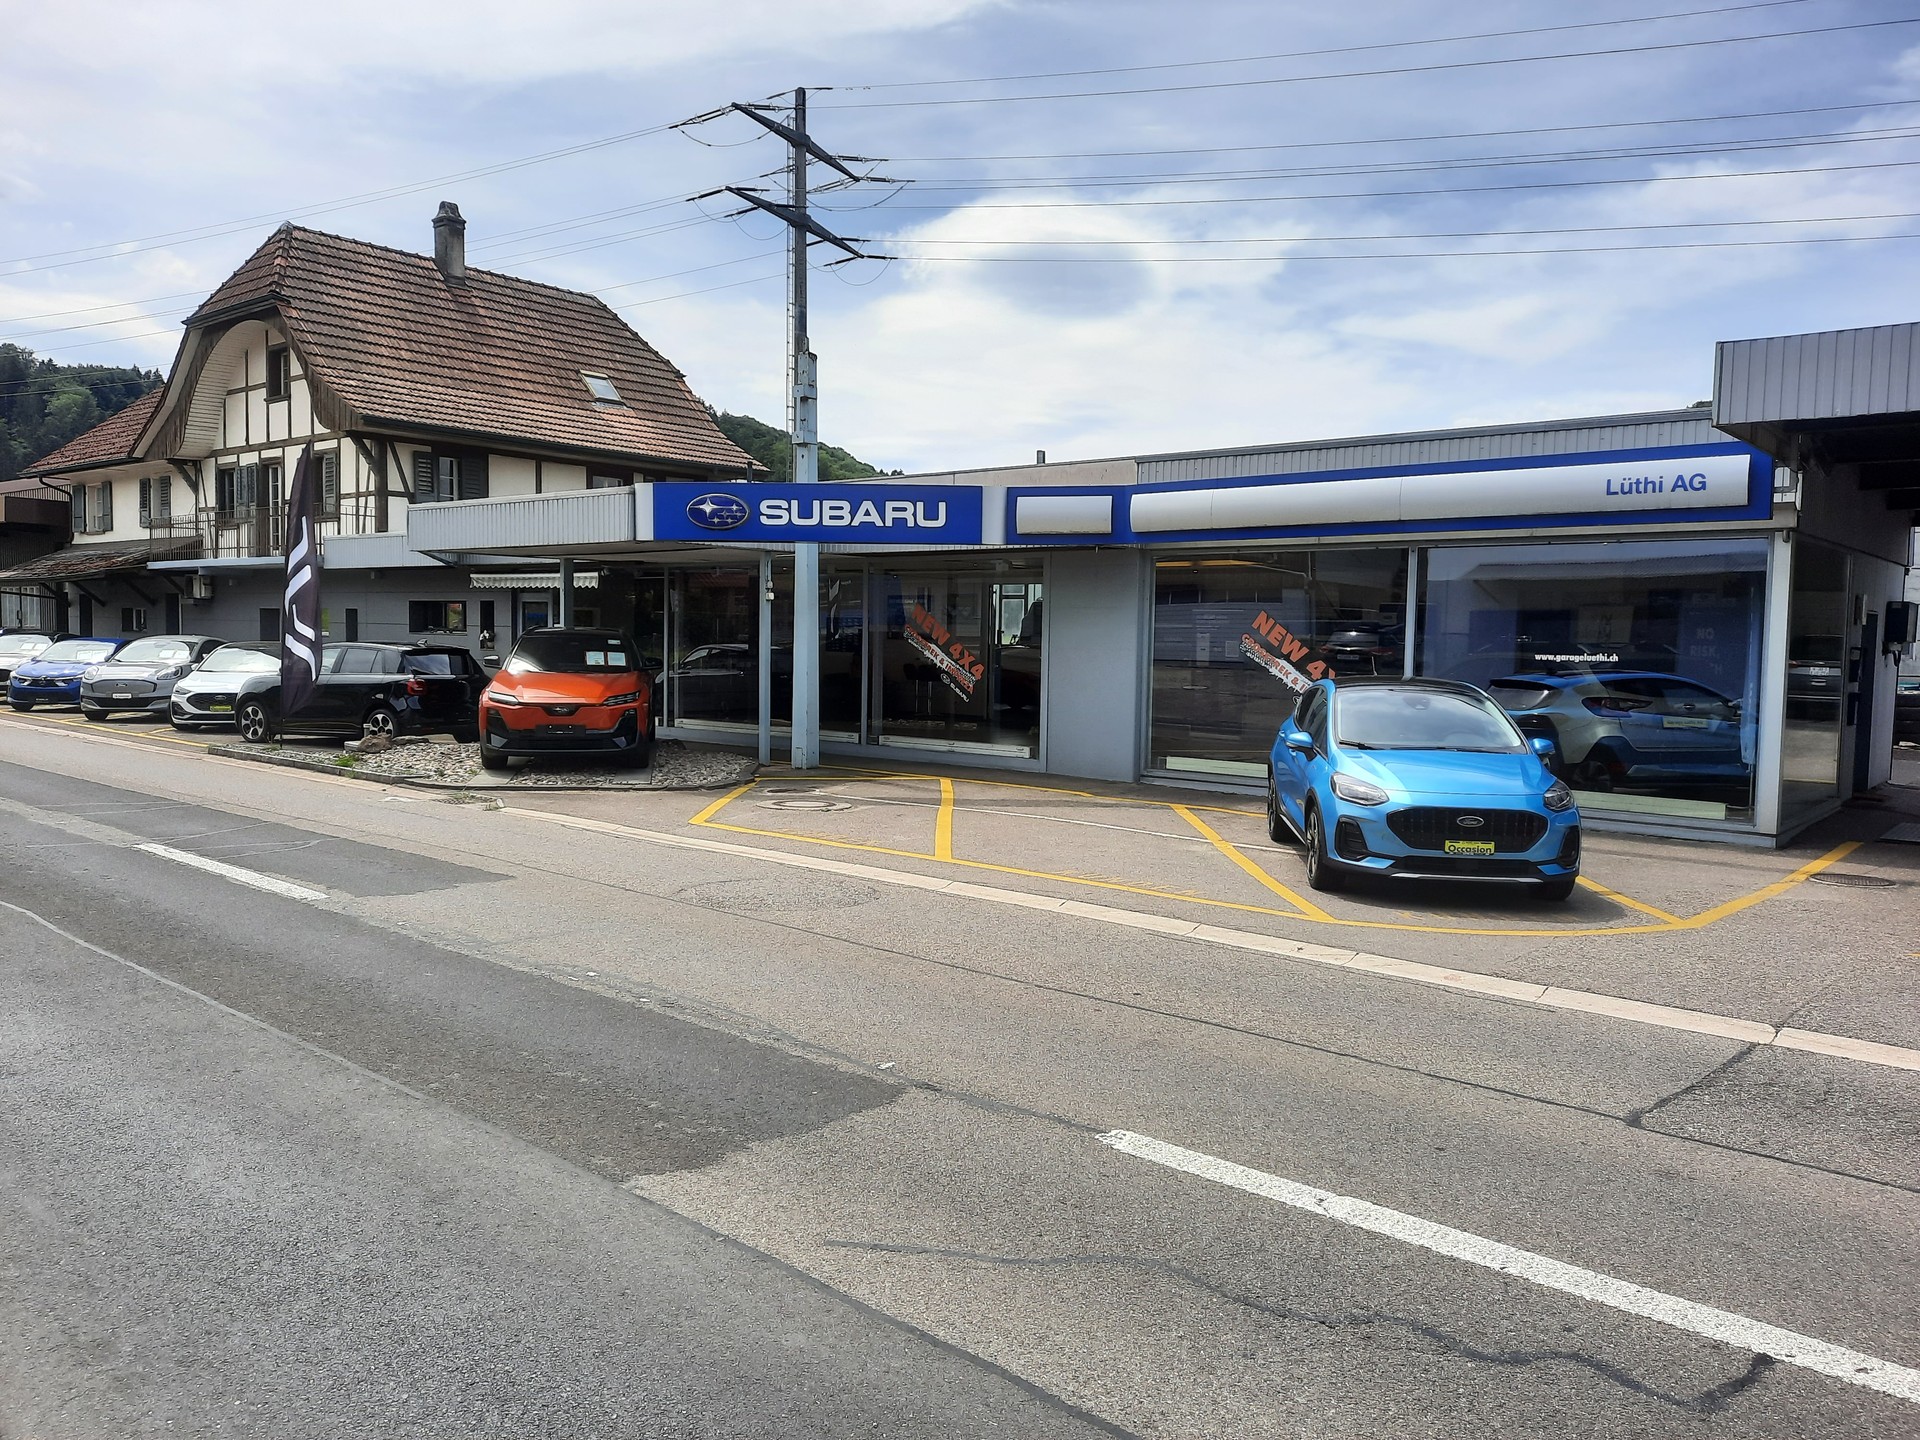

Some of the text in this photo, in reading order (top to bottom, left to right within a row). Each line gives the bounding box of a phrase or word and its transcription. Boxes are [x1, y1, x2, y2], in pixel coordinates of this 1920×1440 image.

[1606, 472, 1708, 496] Lüthi AG
[759, 498, 947, 528] SUBARU
[911, 602, 985, 681] NEW 4X4
[1251, 610, 1310, 663] NEW
[1534, 653, 1619, 663] www.garageluethi.ch
[949, 682, 970, 703] SUBARU
[1448, 844, 1492, 854] Occasion
